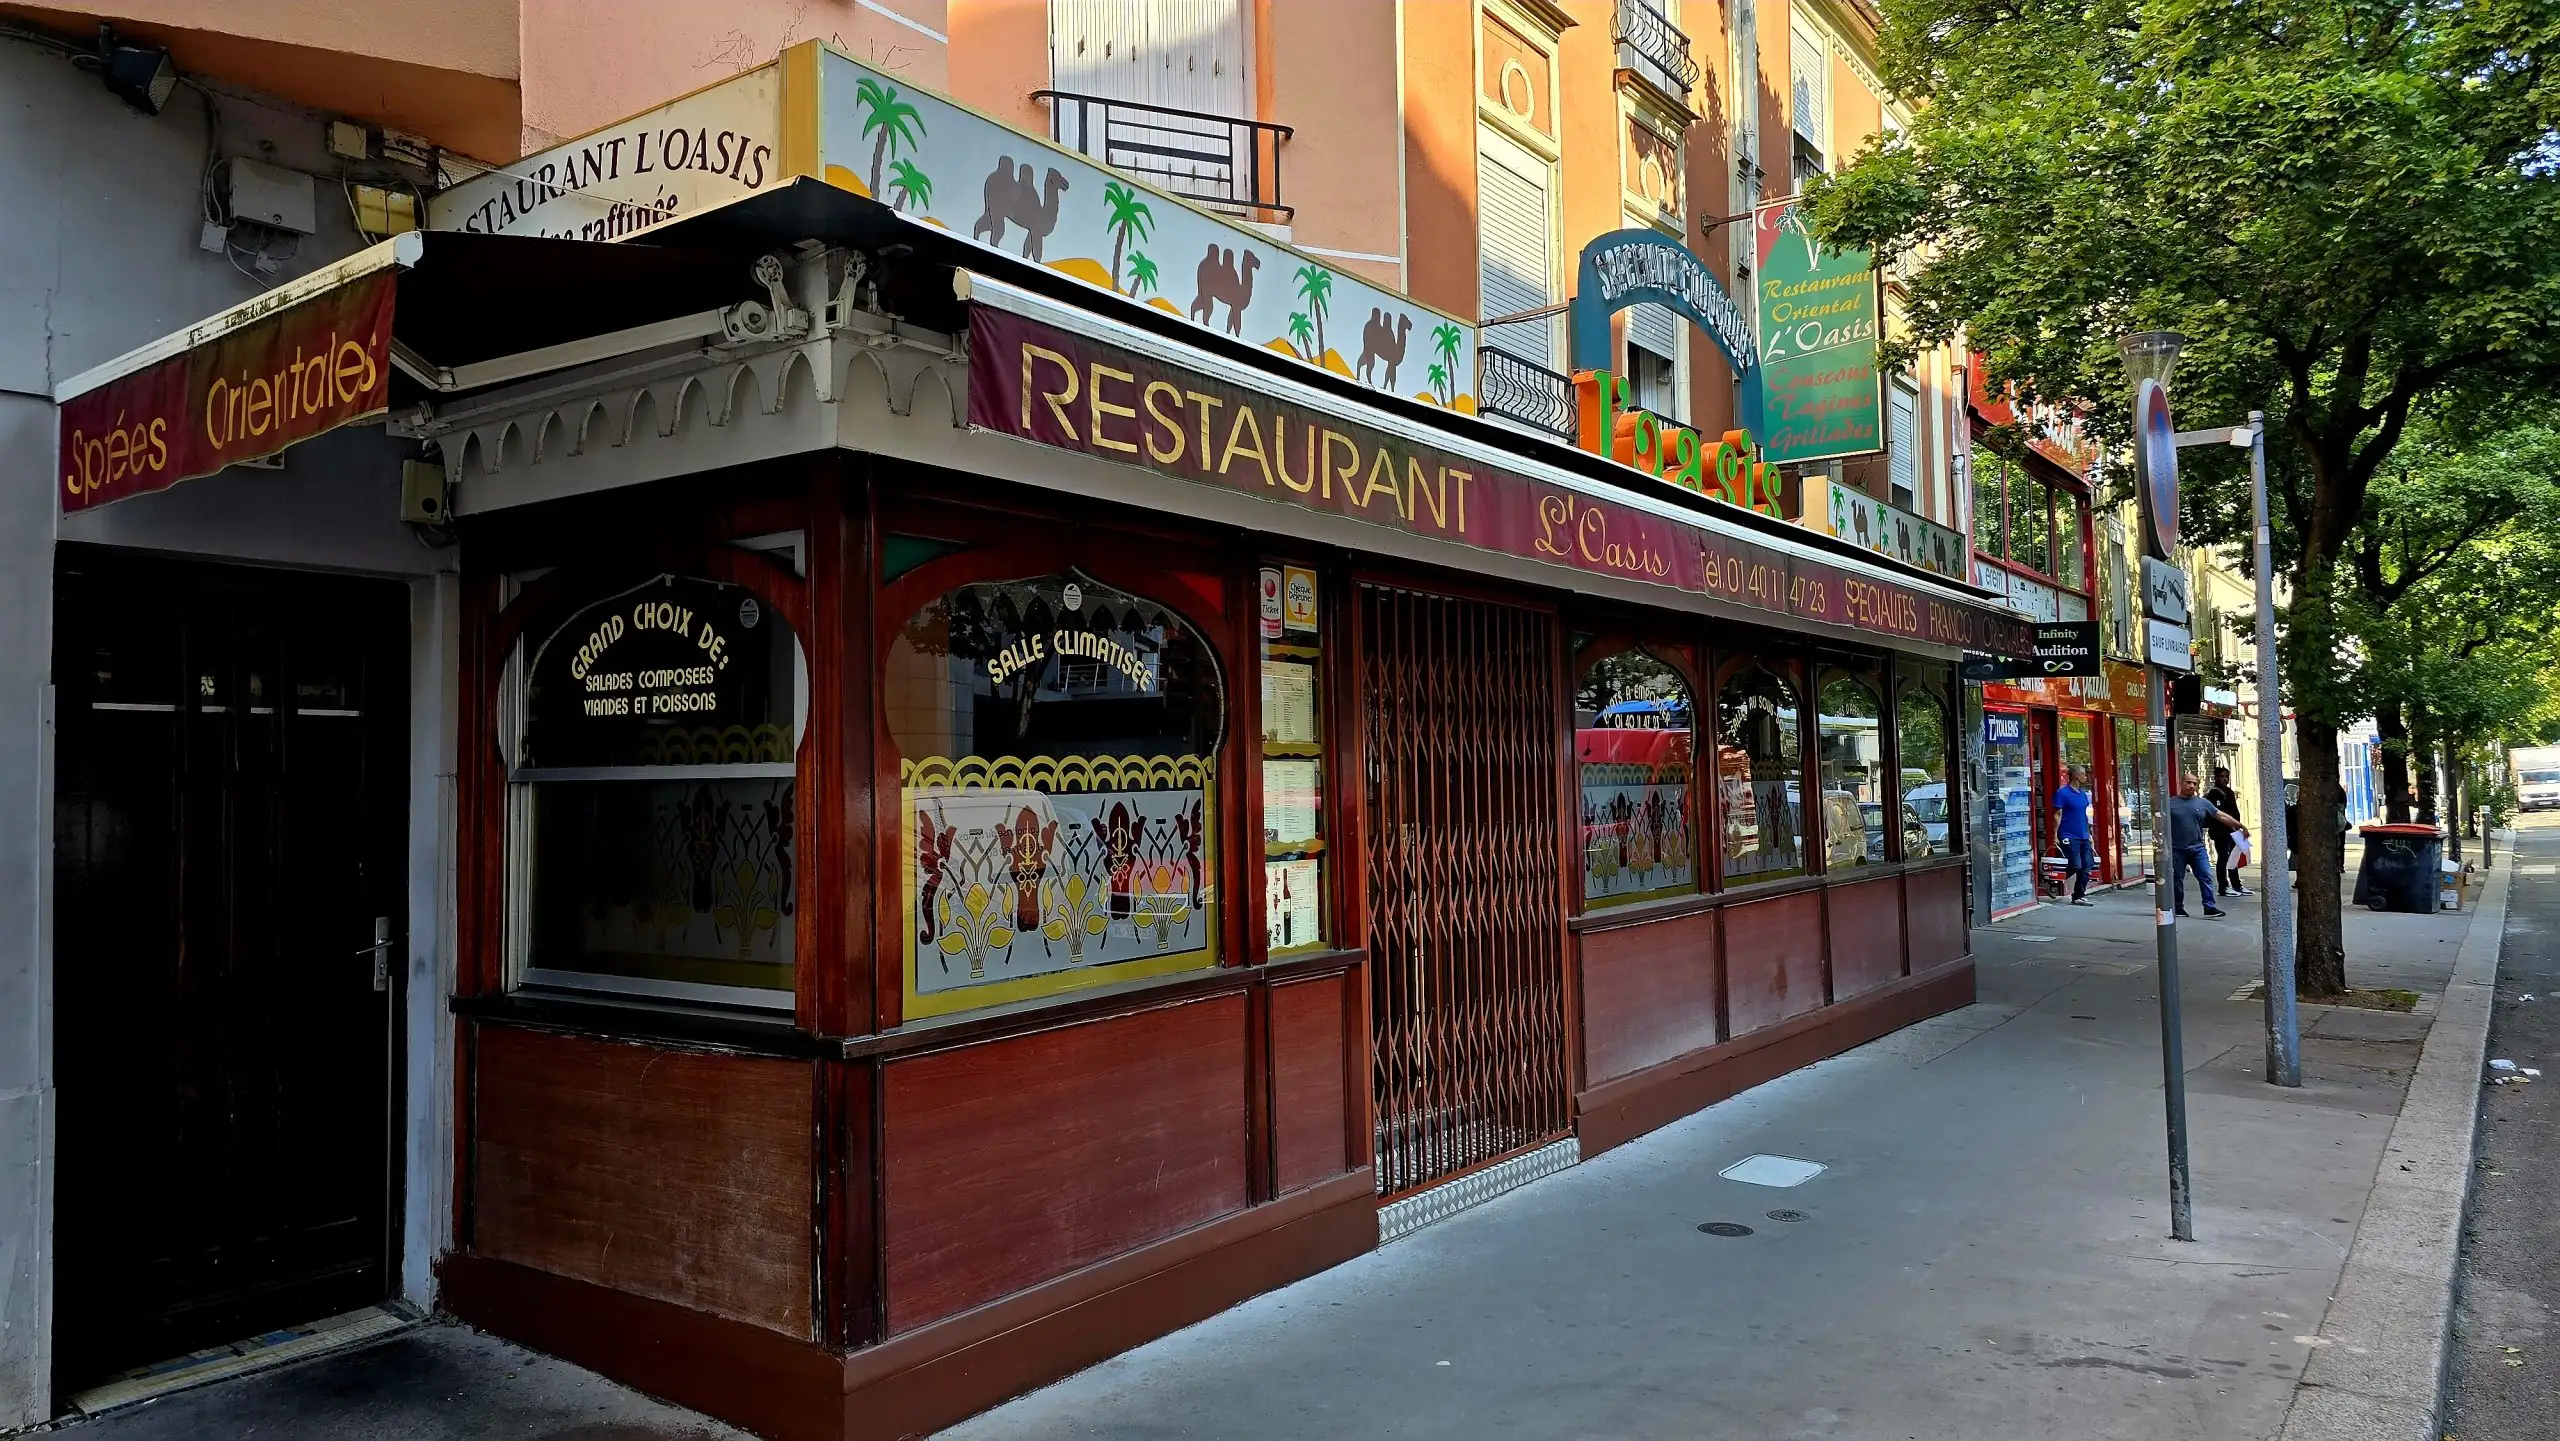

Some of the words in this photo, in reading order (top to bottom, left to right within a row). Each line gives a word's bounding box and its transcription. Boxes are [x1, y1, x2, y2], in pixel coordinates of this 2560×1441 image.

[456, 137, 626, 234] STAURANT
[634, 128, 771, 190] L'OASIS
[1762, 270, 1872, 303] Restaurant
[1772, 293, 1862, 323] Oriental
[1764, 317, 1873, 362] L'Oasis
[206, 331, 378, 450] Orientales
[1021, 342, 1473, 534] RESTAURANT
[1535, 494, 1671, 577] L'Oasis
[1727, 557, 1745, 594] 01
[1748, 564, 1767, 599] 40
[1772, 569, 1786, 602] 11
[1789, 575, 1806, 609] 47
[1809, 578, 1826, 614] 23
[1929, 601, 1973, 644] FRANCO
[1262, 604, 1280, 615] Ticket
[571, 615, 624, 680] GRAND
[634, 602, 693, 638] CHOIX
[2038, 629, 2079, 640] Infinity
[987, 633, 1045, 685] SALLE
[1053, 630, 1154, 692] CLIMATISEE
[2032, 645, 2089, 657] Audition
[586, 672, 633, 692] SALADES
[638, 666, 714, 689] COMPOSEES
[1626, 685, 1631, 701] A
[584, 697, 629, 717] VIANDES
[634, 697, 647, 715] ET
[652, 692, 716, 713] POISSONS
[1614, 713, 1623, 729] 01
[1996, 719, 2019, 738] TOLLENS
